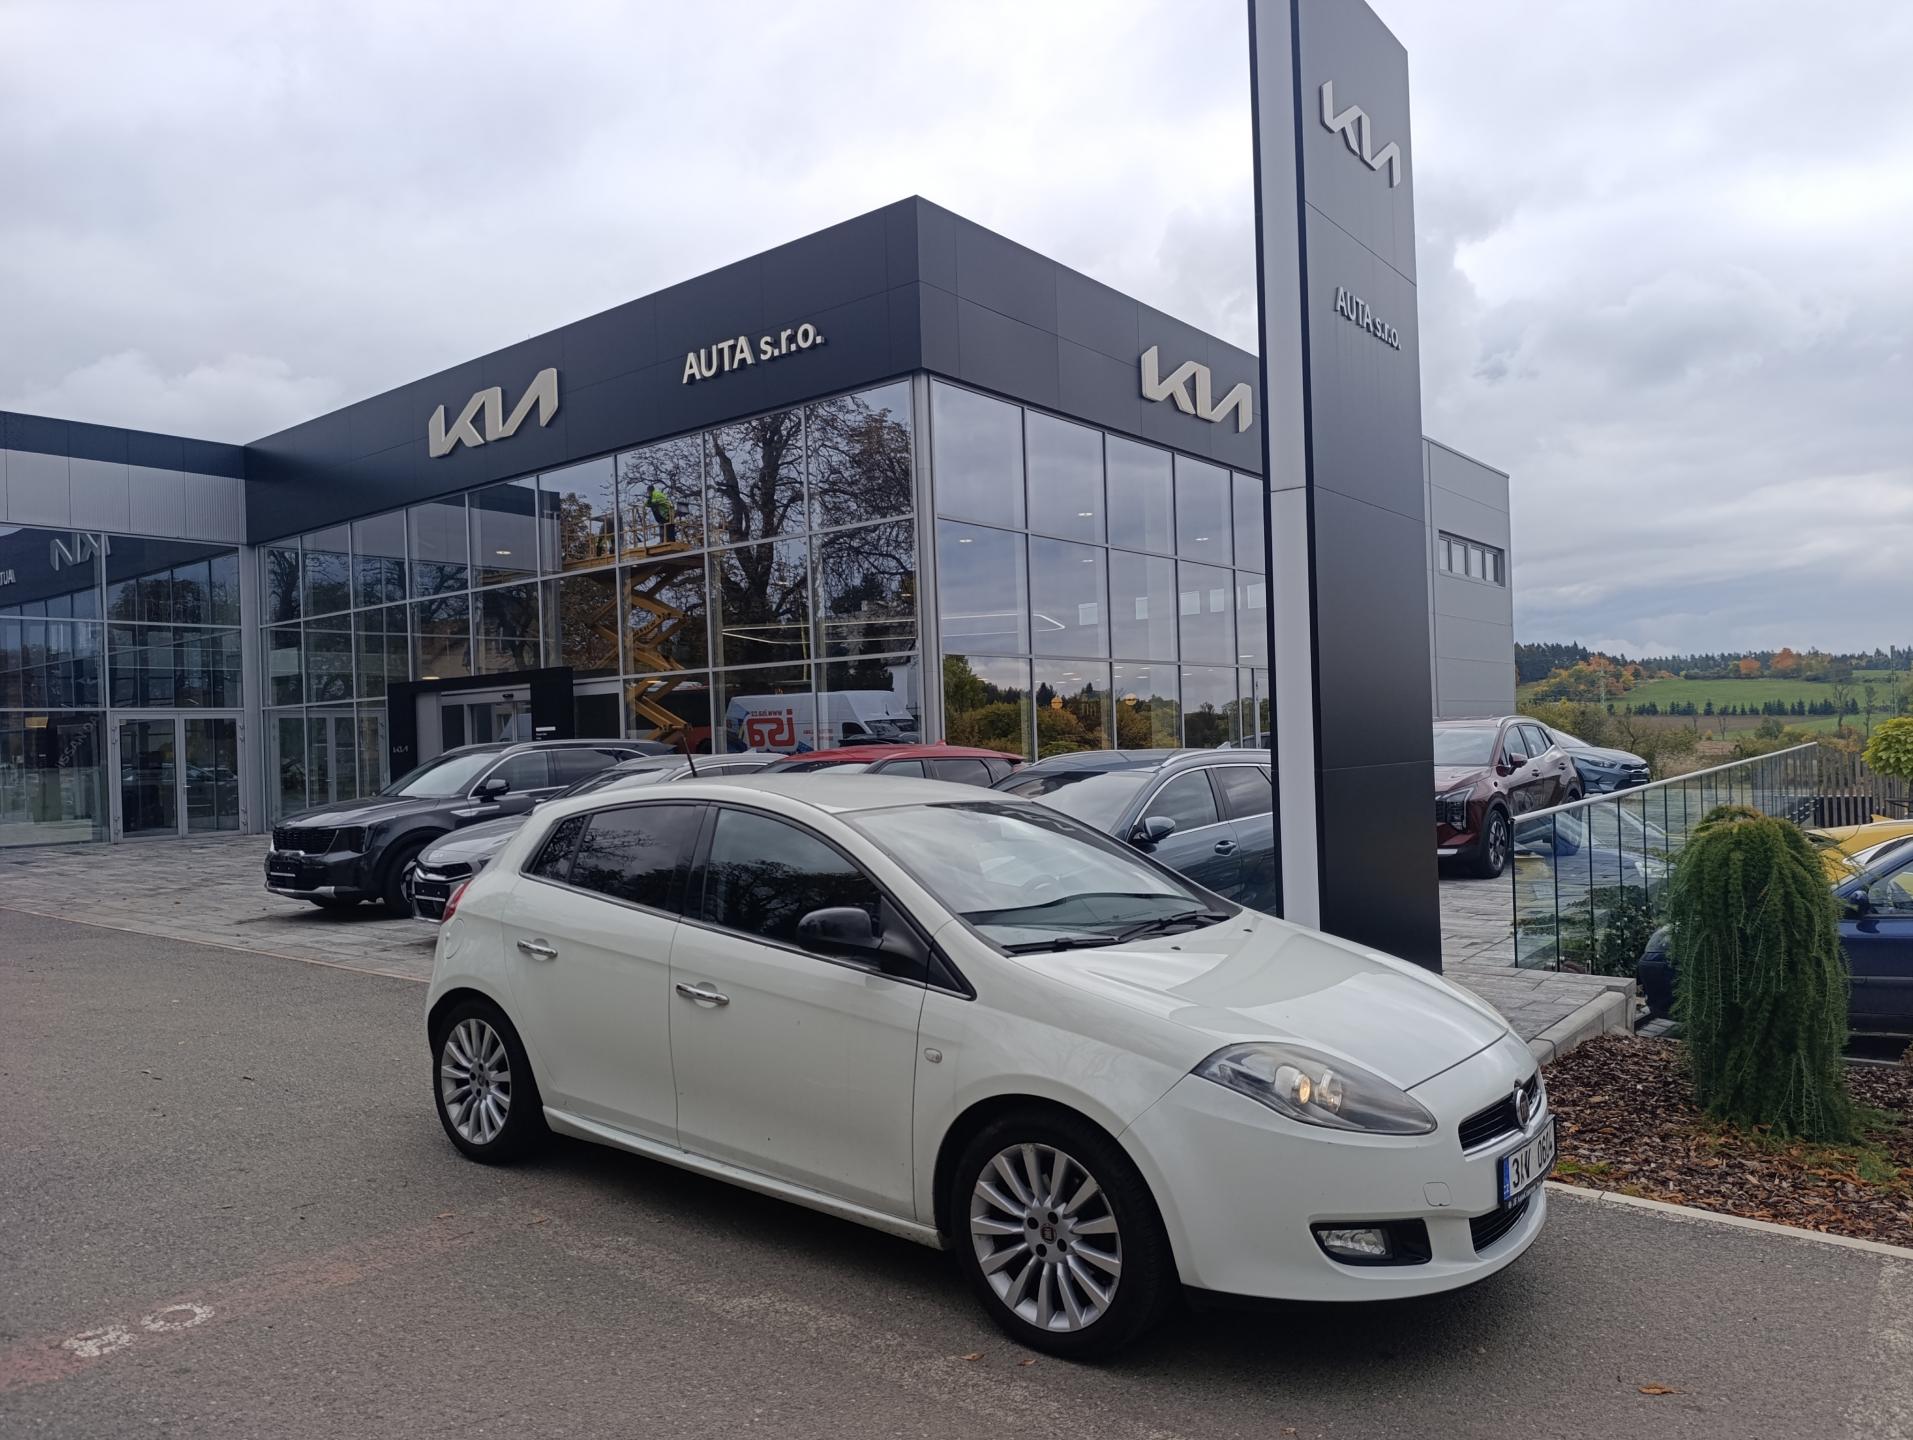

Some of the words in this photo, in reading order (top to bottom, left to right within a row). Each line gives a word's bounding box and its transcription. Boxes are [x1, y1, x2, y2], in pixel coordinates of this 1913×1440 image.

[1320, 79, 1401, 188] KIA
[683, 335, 755, 384] AUTA
[760, 323, 824, 361] s.r.o.
[1335, 286, 1373, 333] AUTA
[1374, 313, 1402, 351] s.r.o.
[428, 367, 558, 458] KIA
[1141, 345, 1253, 433] KIA
